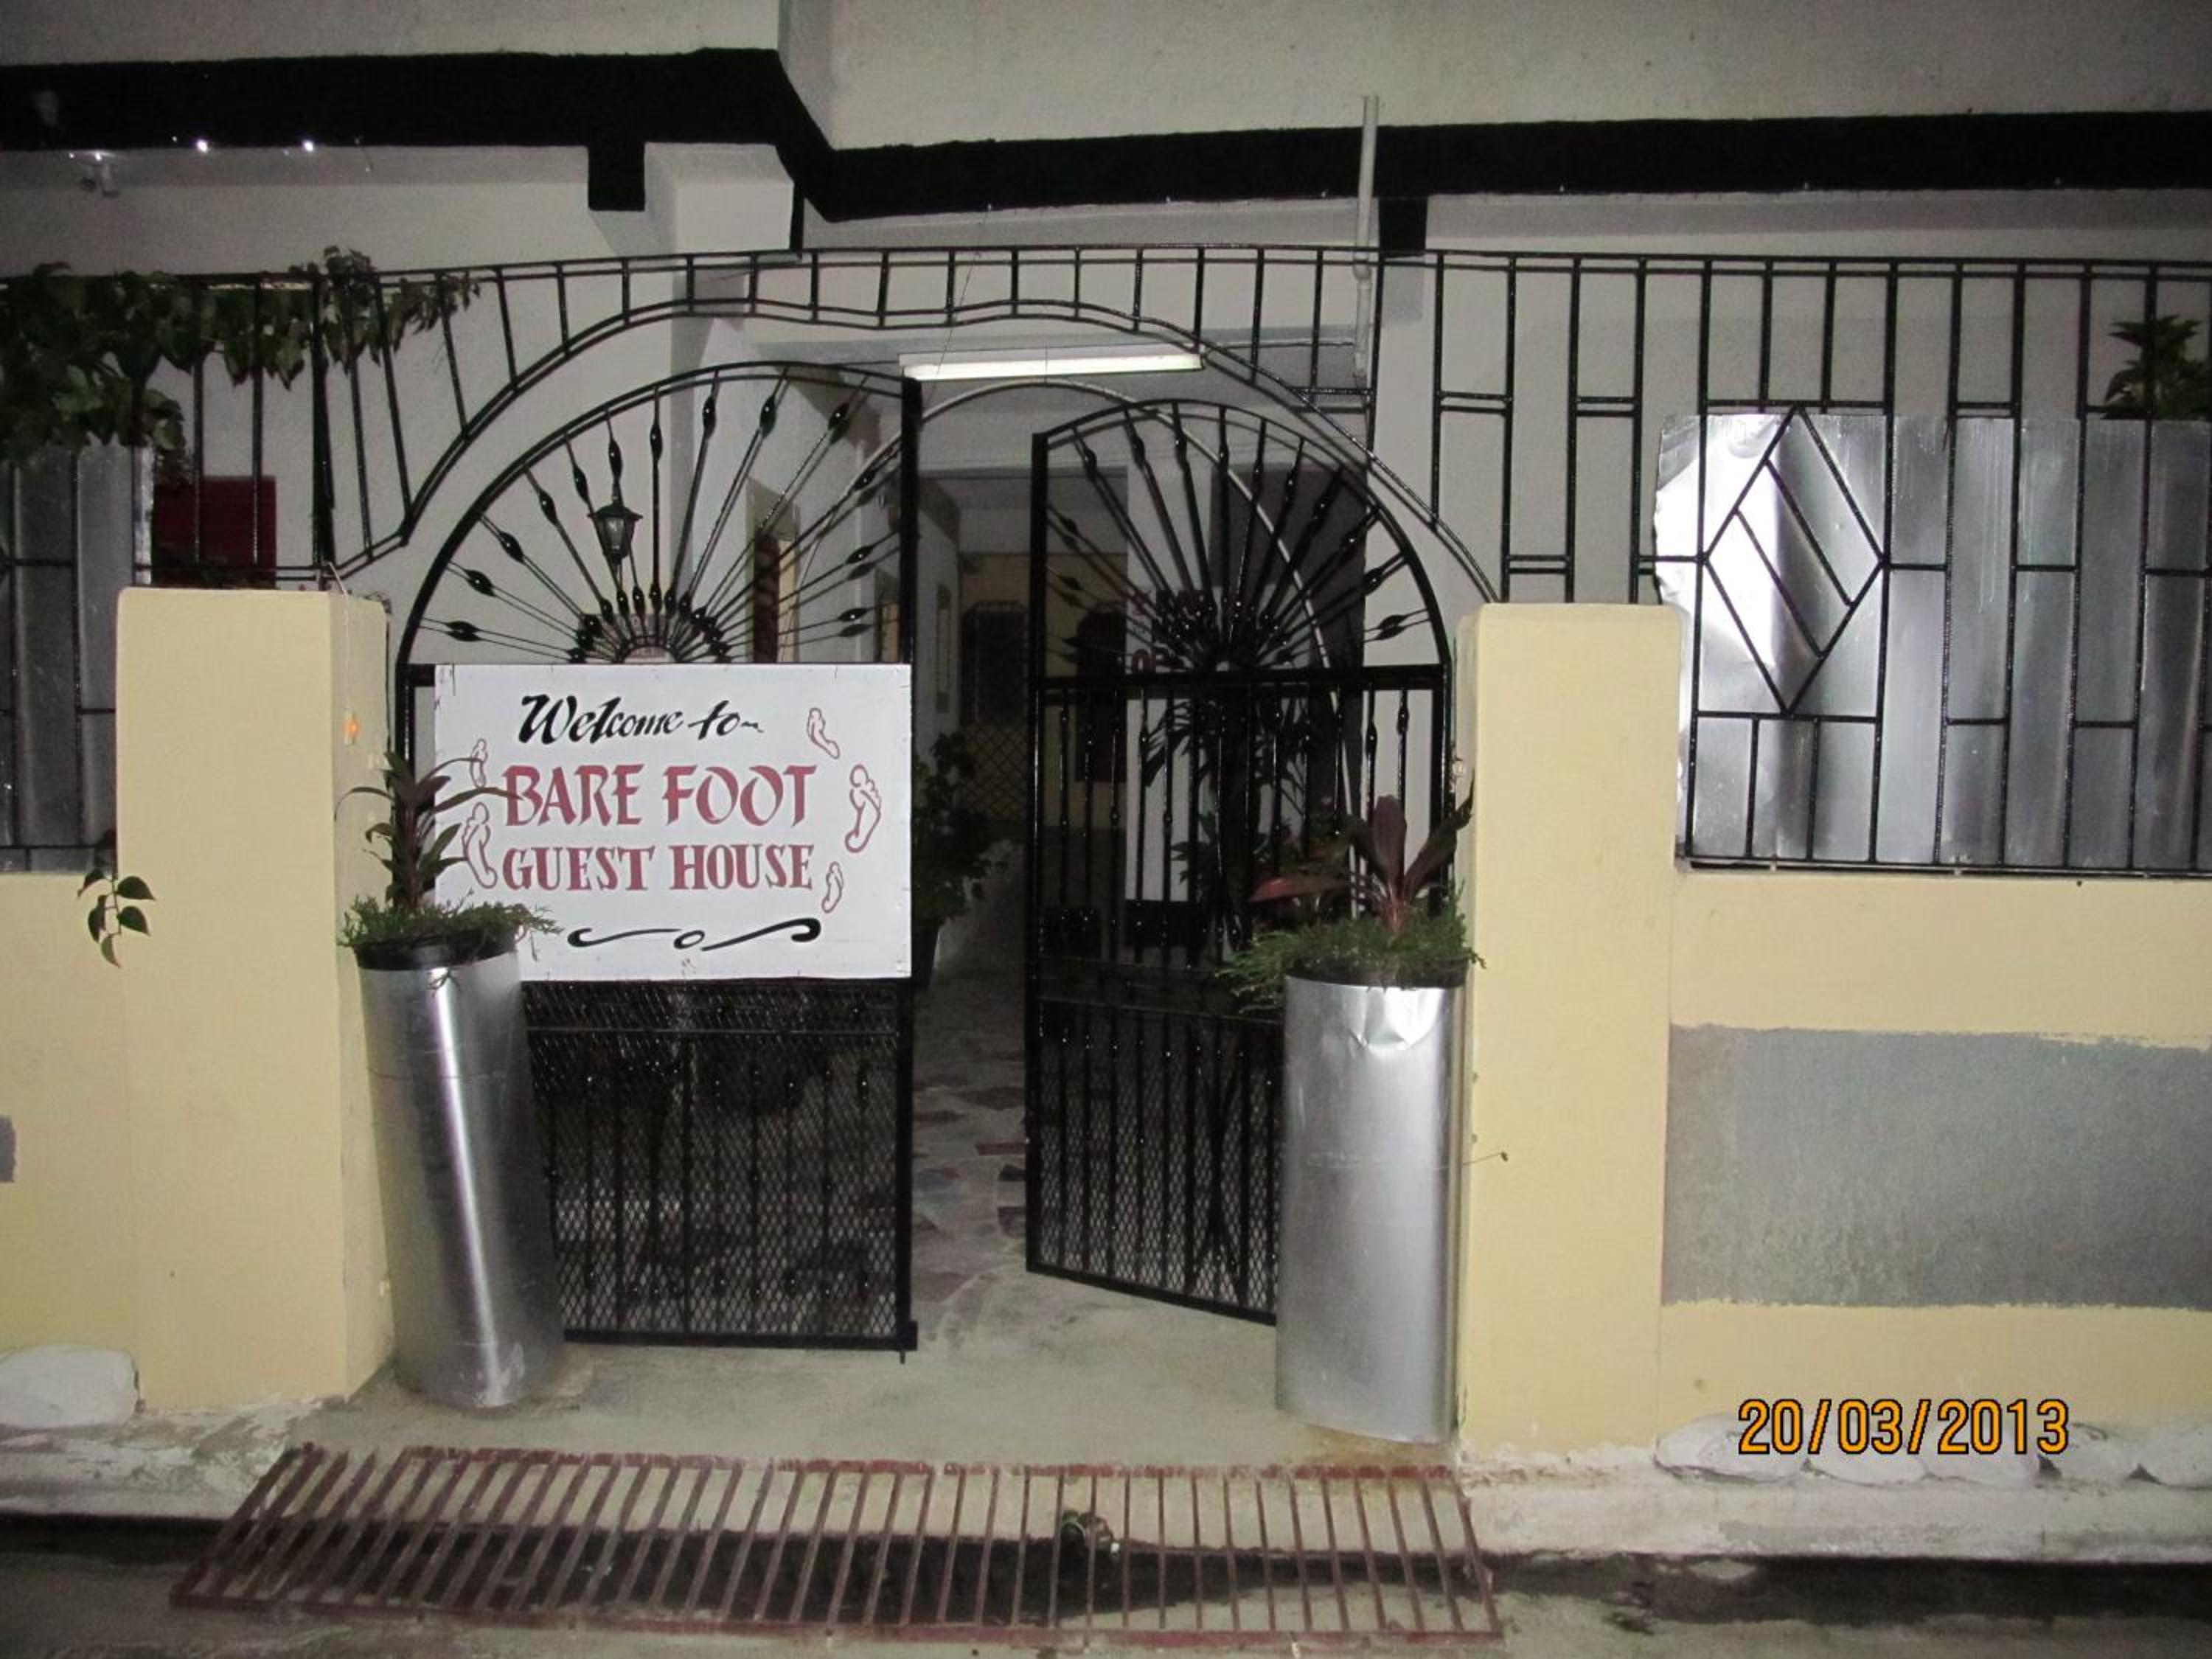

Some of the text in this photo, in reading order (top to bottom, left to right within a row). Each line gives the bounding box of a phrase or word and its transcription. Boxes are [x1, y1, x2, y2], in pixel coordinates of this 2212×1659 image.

[518, 694, 684, 745] Welcome
[501, 764, 817, 827] BARE FOOT
[501, 844, 815, 891] GUEST HOUSE
